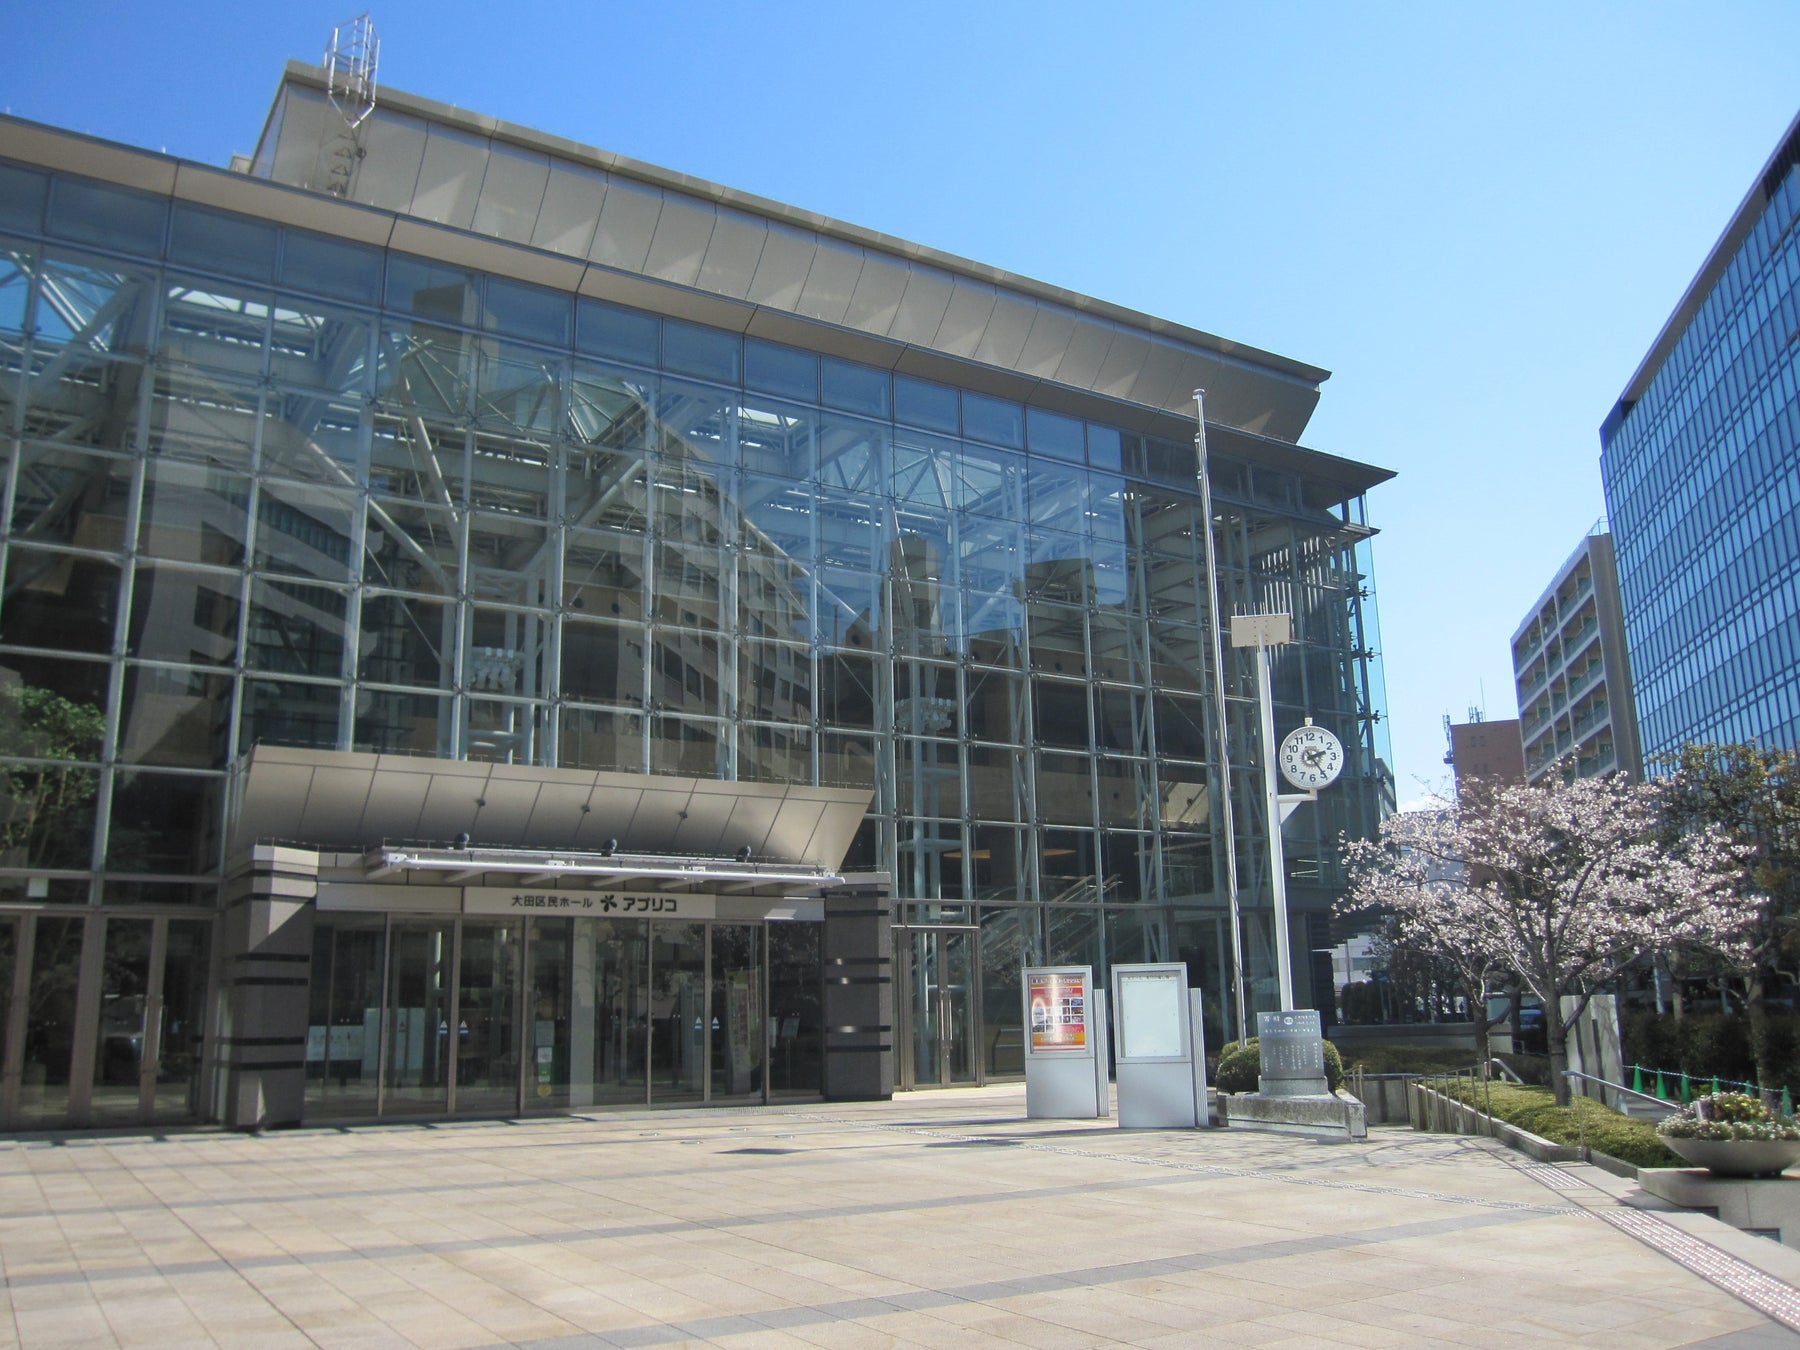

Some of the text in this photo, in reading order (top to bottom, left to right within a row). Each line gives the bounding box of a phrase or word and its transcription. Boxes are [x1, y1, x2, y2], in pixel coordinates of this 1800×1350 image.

[1304, 733, 1315, 741] 12
[1288, 745, 1298, 753] 10
[1326, 742, 1332, 750] 2
[1286, 755, 1292, 763] 9
[1330, 752, 1336, 760] 3
[1290, 765, 1297, 773] 8
[1300, 772, 1305, 780] 7
[1310, 774, 1316, 782] 6
[1320, 771, 1327, 779] 5
[511, 895, 677, 912] 大田区民ホール アプリコ
